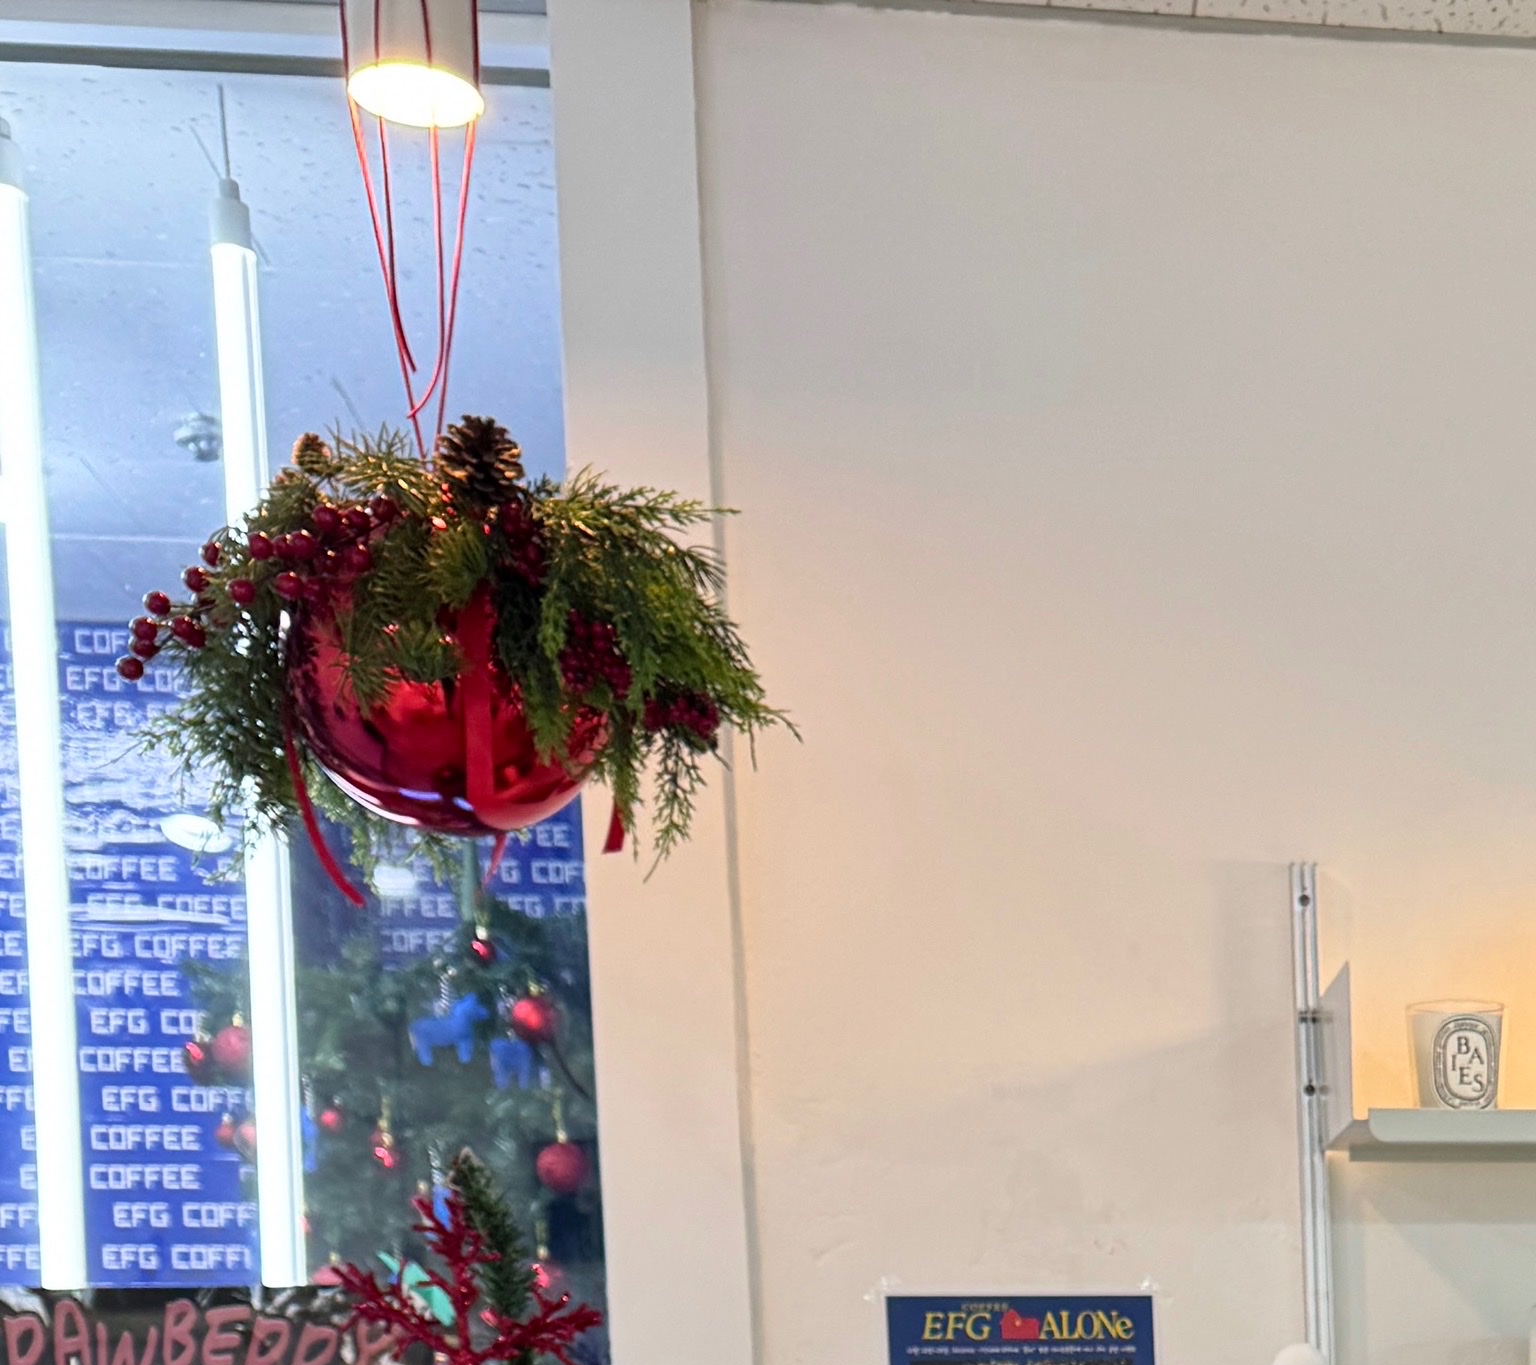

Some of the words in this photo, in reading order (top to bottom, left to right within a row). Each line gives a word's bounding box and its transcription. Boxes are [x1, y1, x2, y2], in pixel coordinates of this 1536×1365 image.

[134, 932, 243, 959] COFFEE
[72, 969, 180, 997] COFFEE
[90, 1007, 148, 1034] EFG
[79, 1046, 188, 1073] COFFEE
[102, 1085, 159, 1112] EFG
[90, 1124, 202, 1151] COFFEE
[90, 1163, 202, 1190] COFFEE
[113, 1202, 170, 1228] EFG
[102, 1243, 159, 1270] EFG
[922, 1312, 991, 1341] EFG
